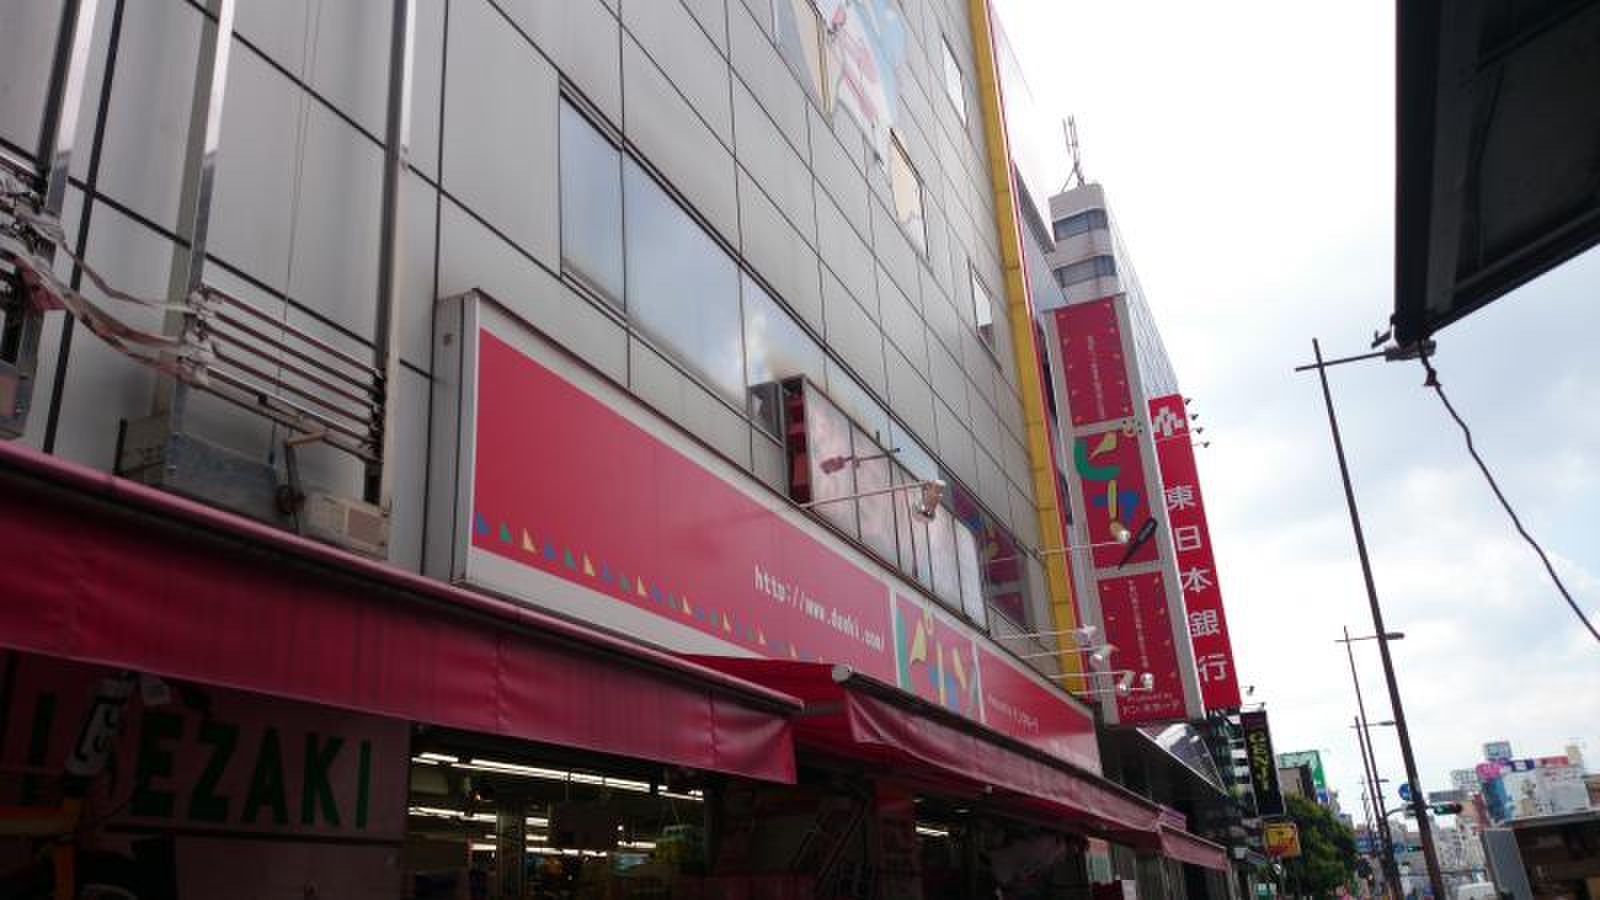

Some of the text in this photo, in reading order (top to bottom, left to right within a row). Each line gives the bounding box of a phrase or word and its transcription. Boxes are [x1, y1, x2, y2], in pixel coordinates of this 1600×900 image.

[1166, 484, 1228, 682] 東日本銀行
